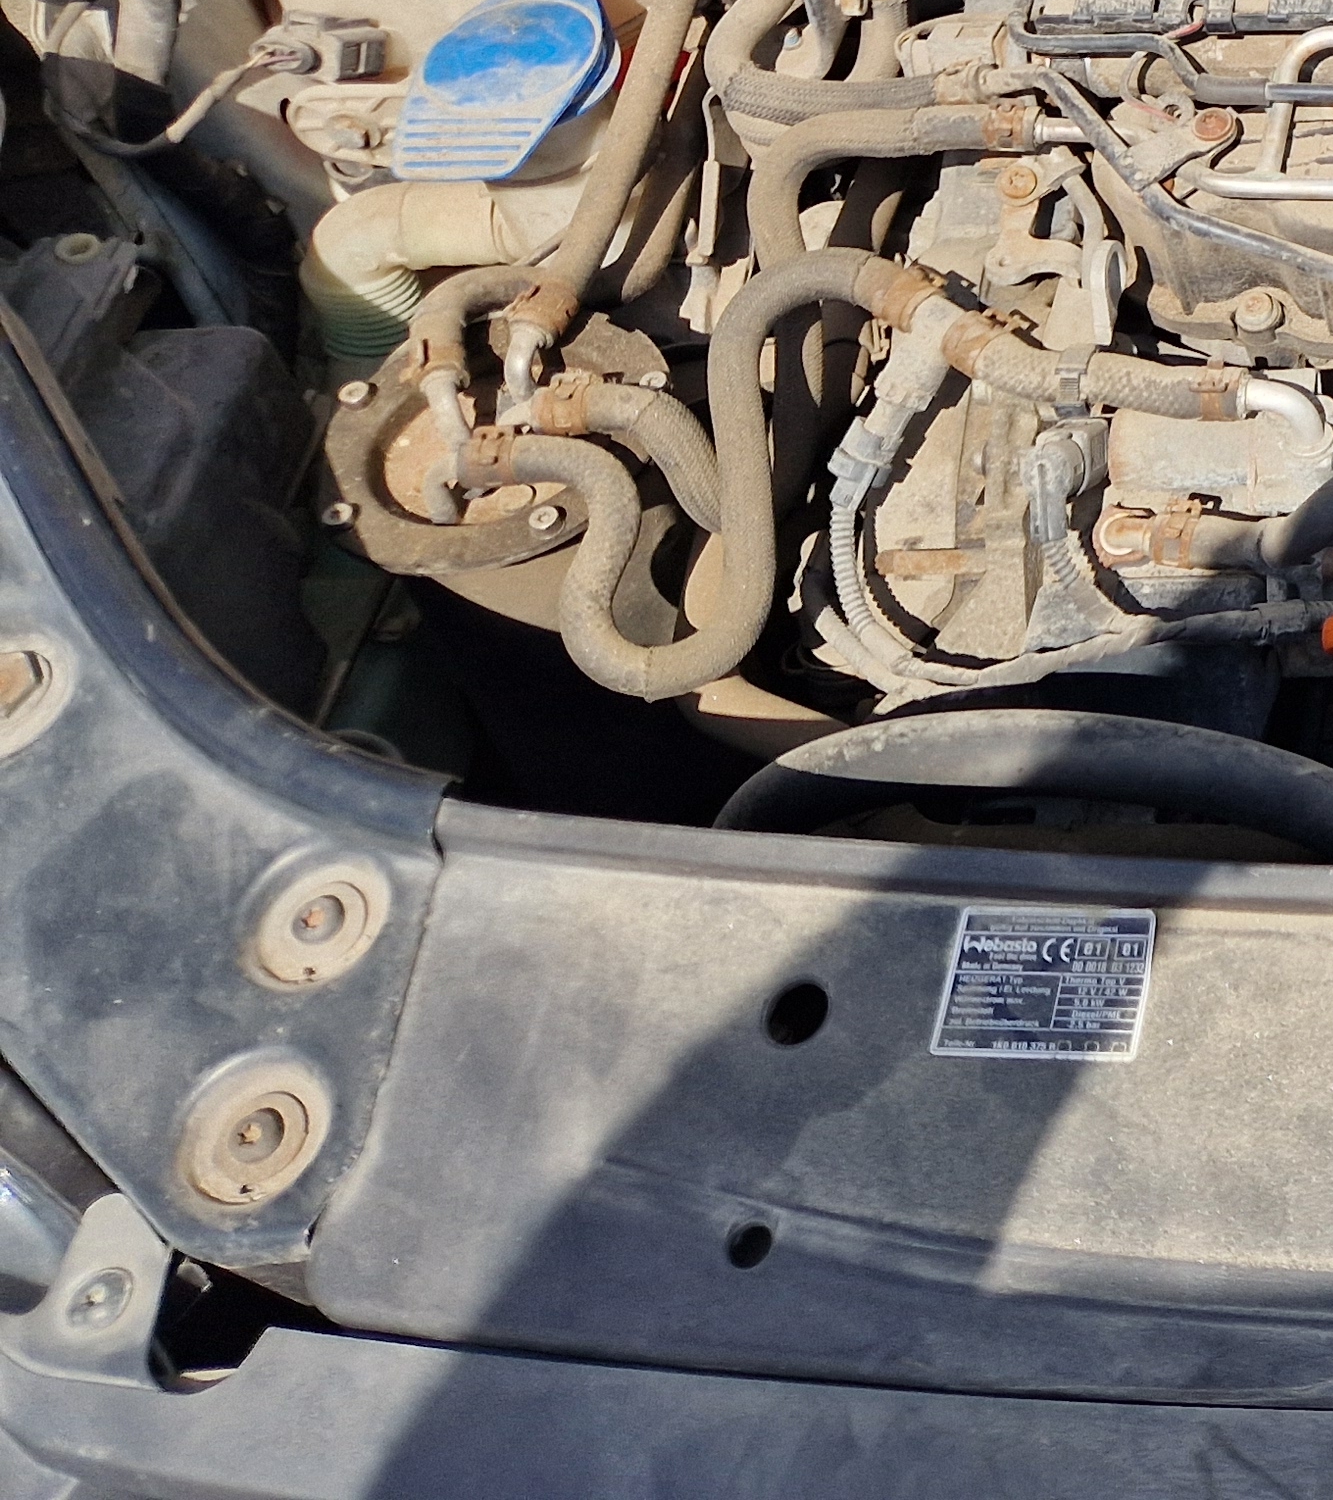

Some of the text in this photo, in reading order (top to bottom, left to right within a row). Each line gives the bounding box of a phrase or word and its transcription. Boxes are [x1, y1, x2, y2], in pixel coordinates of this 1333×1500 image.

[963, 935, 1037, 953] Webasto
[1066, 977, 1097, 985] Thermo
[1101, 977, 1116, 985] Top
